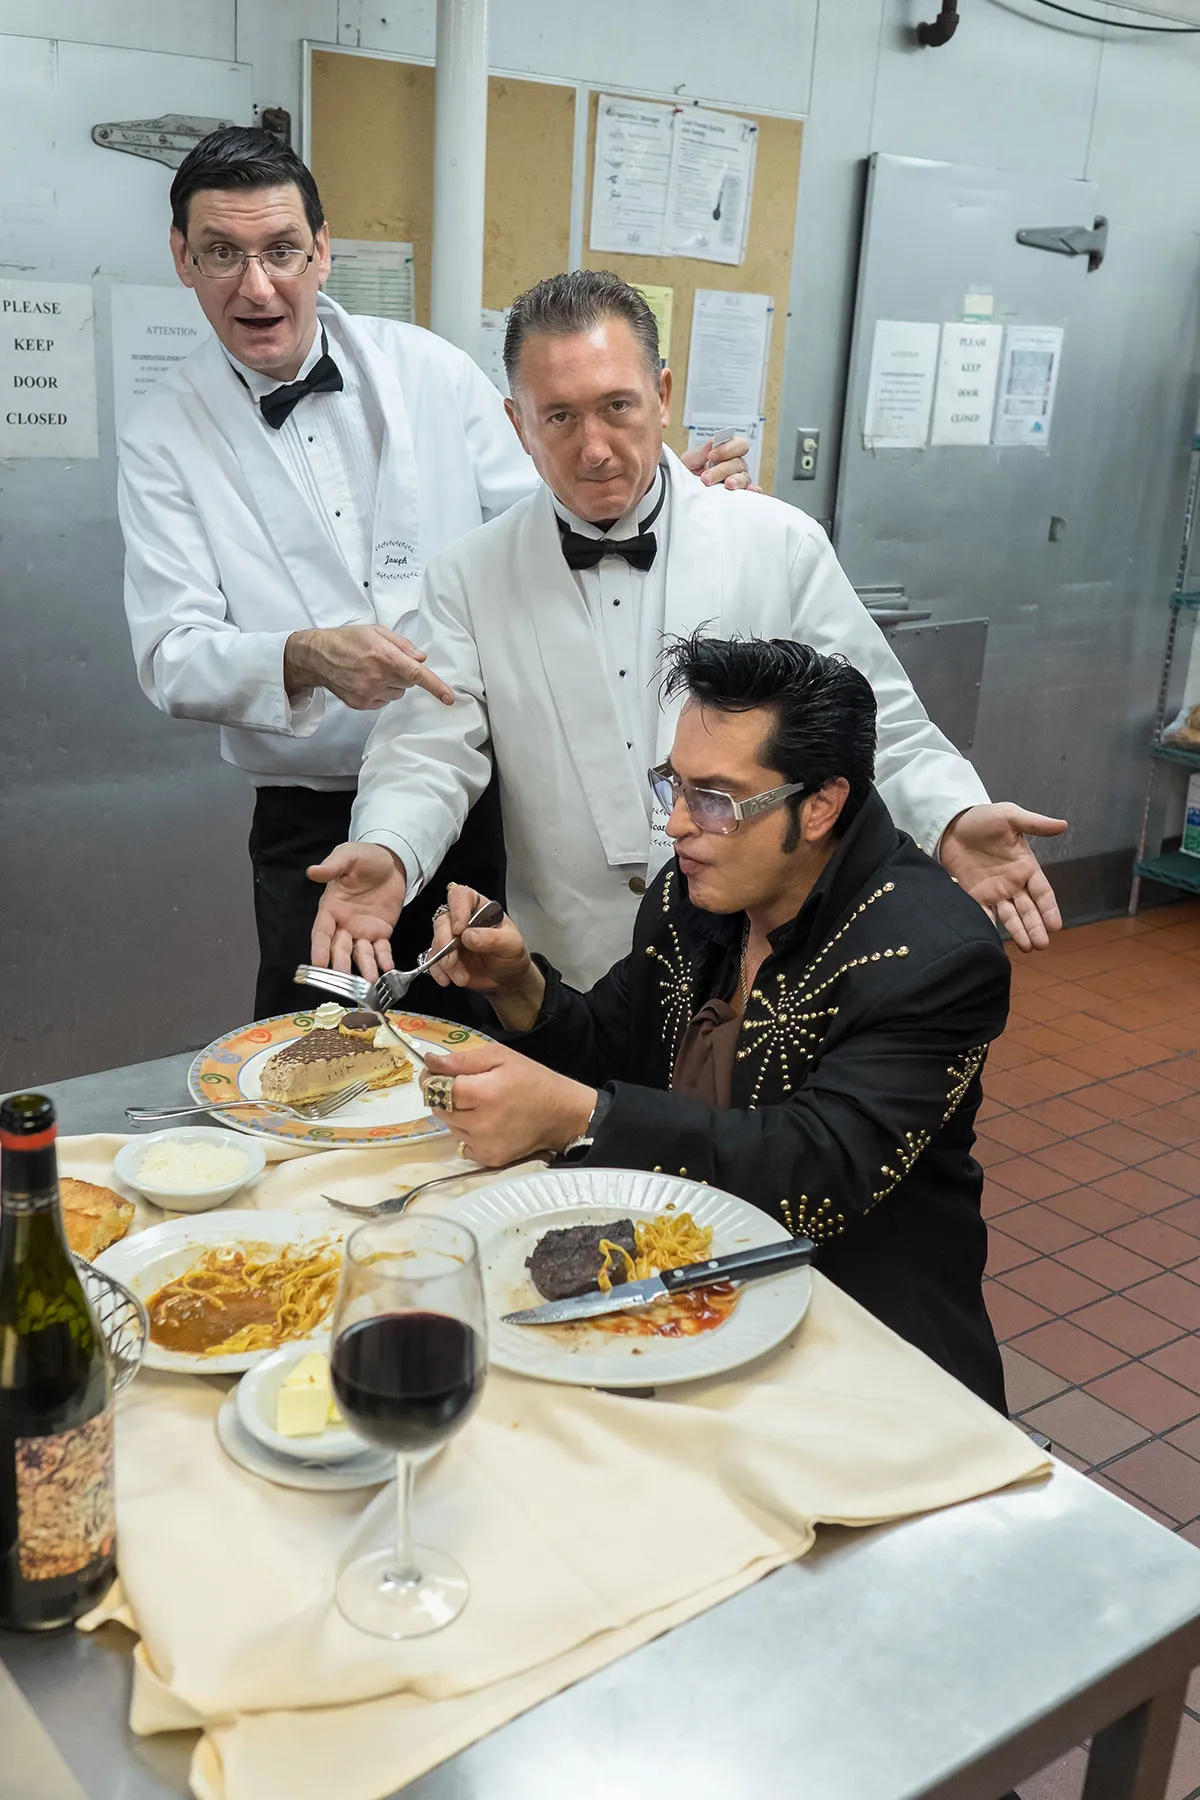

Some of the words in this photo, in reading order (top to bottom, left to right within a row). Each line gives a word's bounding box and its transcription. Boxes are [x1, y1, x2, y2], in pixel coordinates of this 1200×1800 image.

[2, 299, 61, 315] PLEASE
[145, 326, 197, 336] ATTENTION
[14, 338, 55, 351] KEEP
[959, 337, 987, 347] PLEASE
[961, 363, 982, 372] KEEP
[13, 375, 58, 389] DOOR
[957, 388, 979, 397] DOOR
[6, 412, 67, 425] CLOSED
[950, 413, 980, 423] CLOSED
